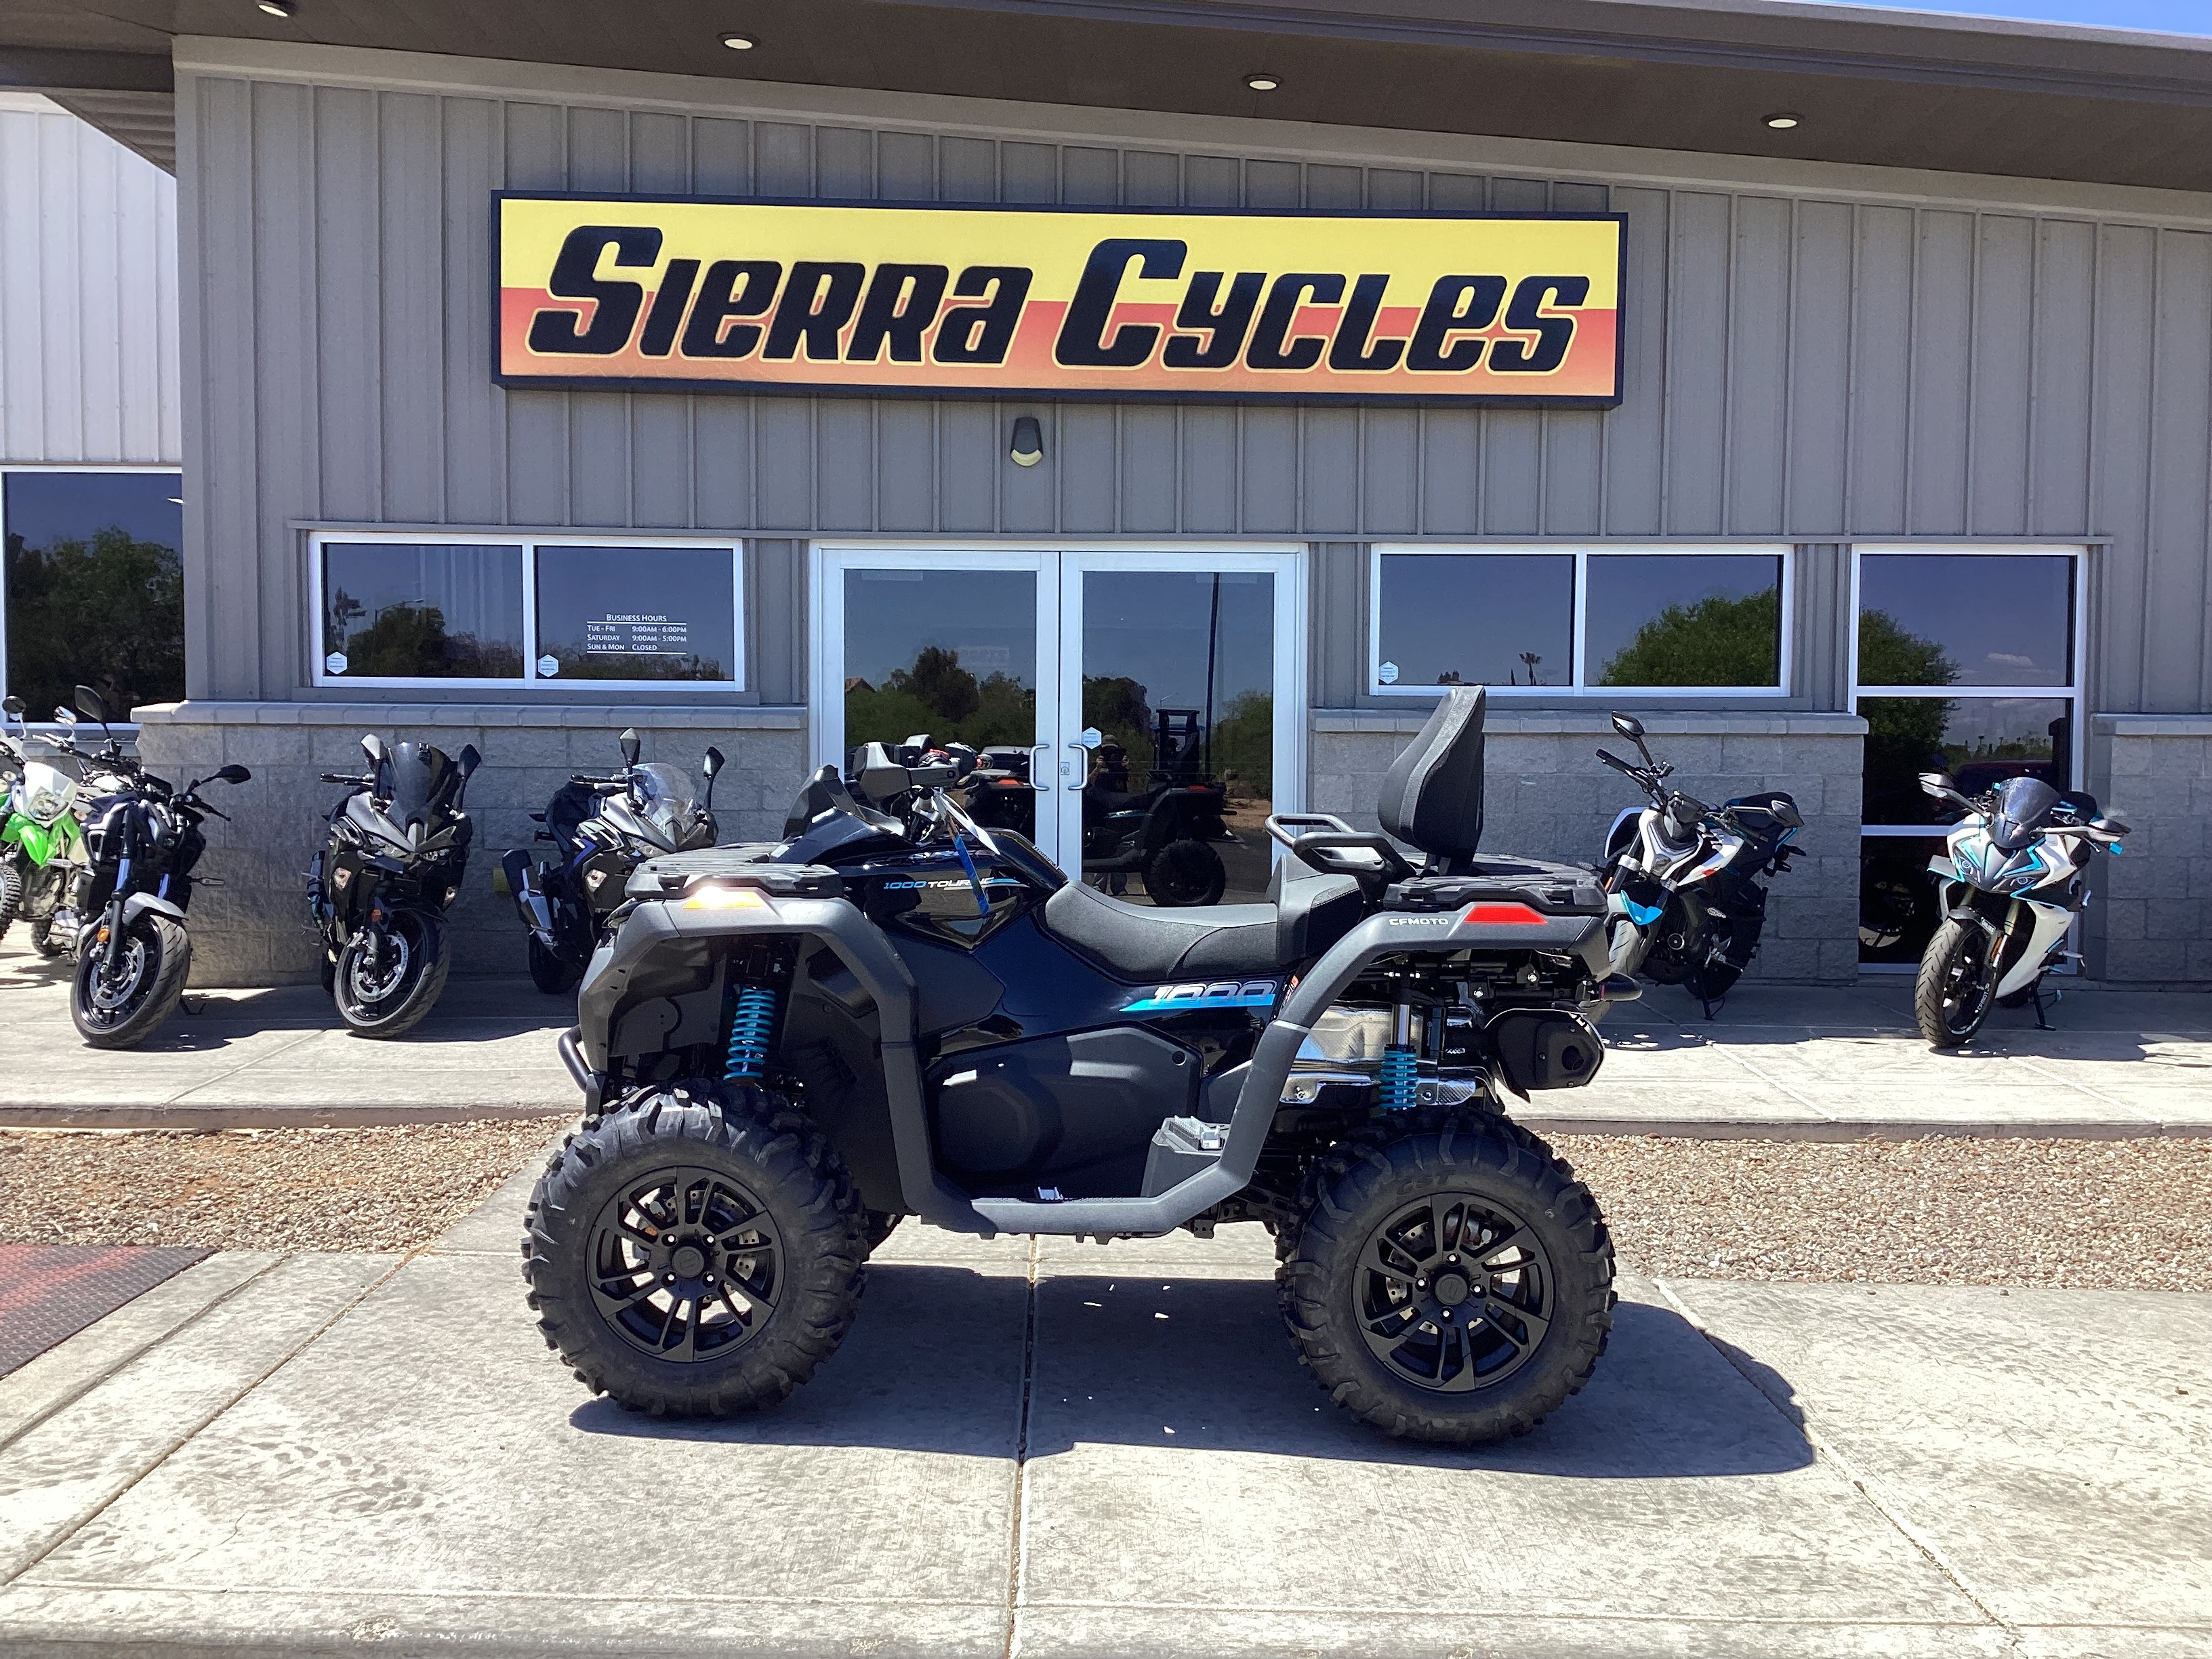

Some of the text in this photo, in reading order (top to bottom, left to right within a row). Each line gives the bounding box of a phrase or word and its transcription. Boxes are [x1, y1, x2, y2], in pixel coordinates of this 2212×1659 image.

[883, 880, 927, 889] 1000
[1389, 918, 1449, 926] CFMOTO
[1152, 980, 1278, 1004] 1000
